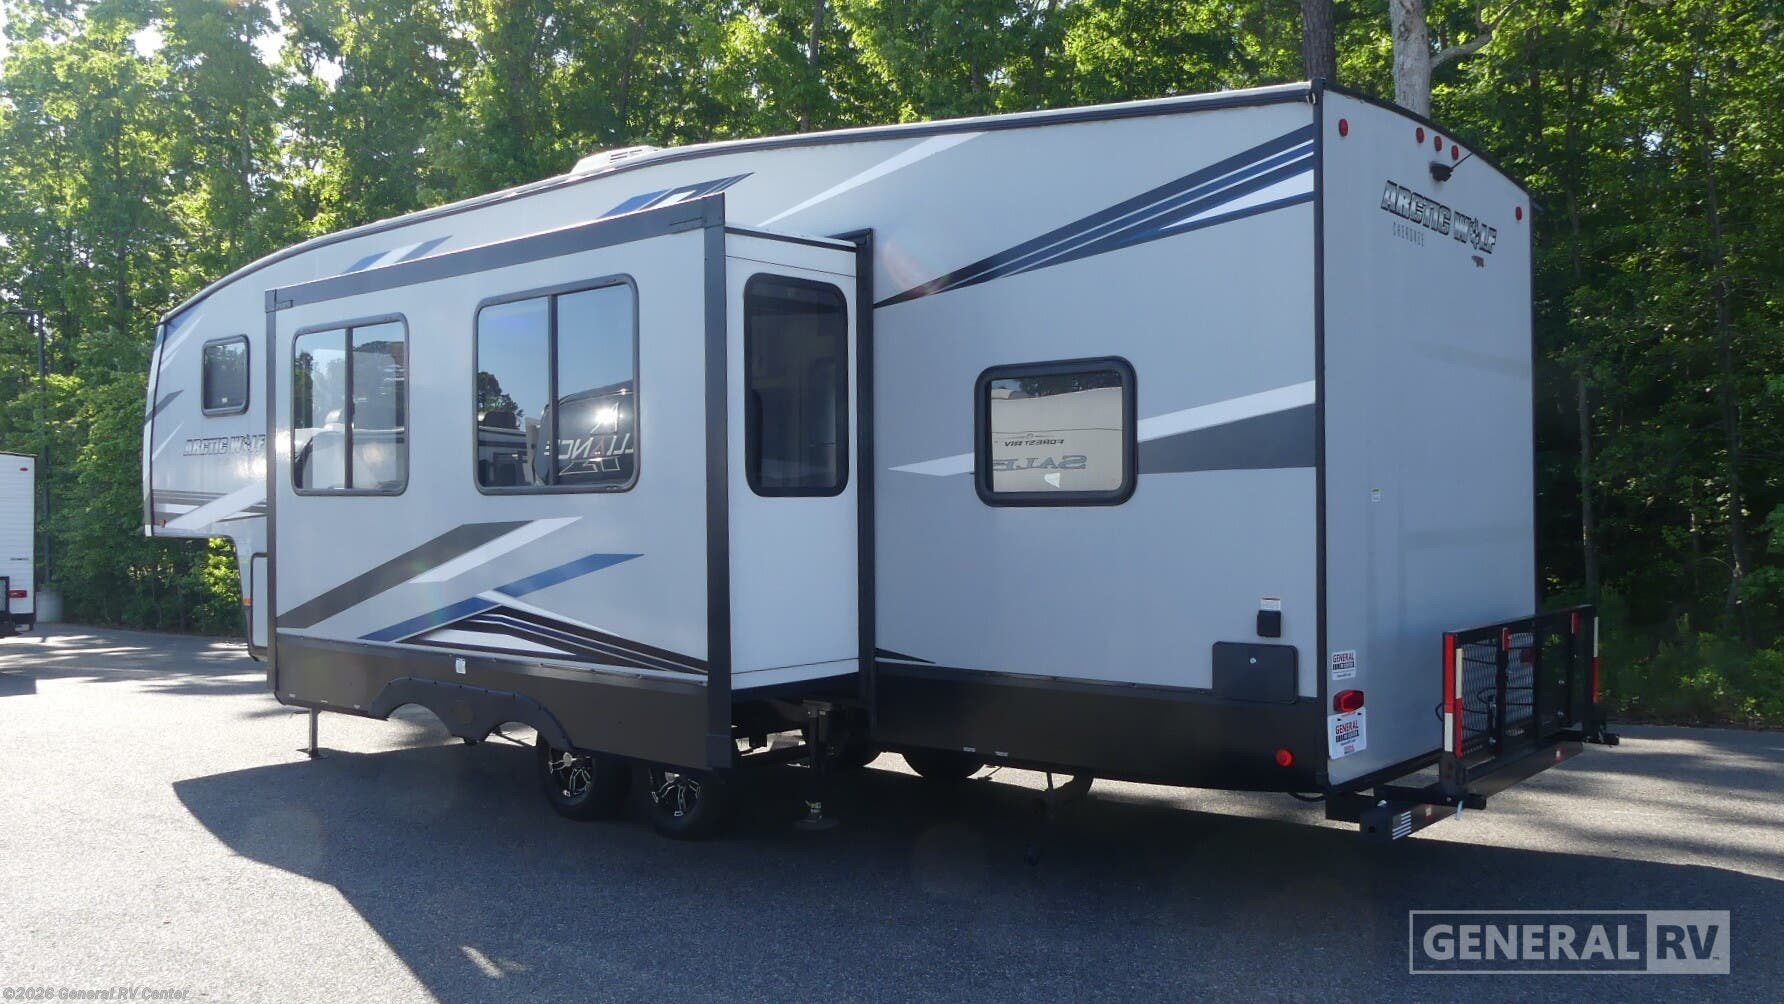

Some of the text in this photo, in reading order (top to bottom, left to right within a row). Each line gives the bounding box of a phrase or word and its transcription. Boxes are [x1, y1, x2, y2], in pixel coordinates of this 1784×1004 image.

[1380, 180, 1452, 235] ARCTIC
[183, 436, 229, 457] ARCTIC
[1332, 651, 1355, 664] GENERAL
[1335, 719, 1359, 735] GENERAL
